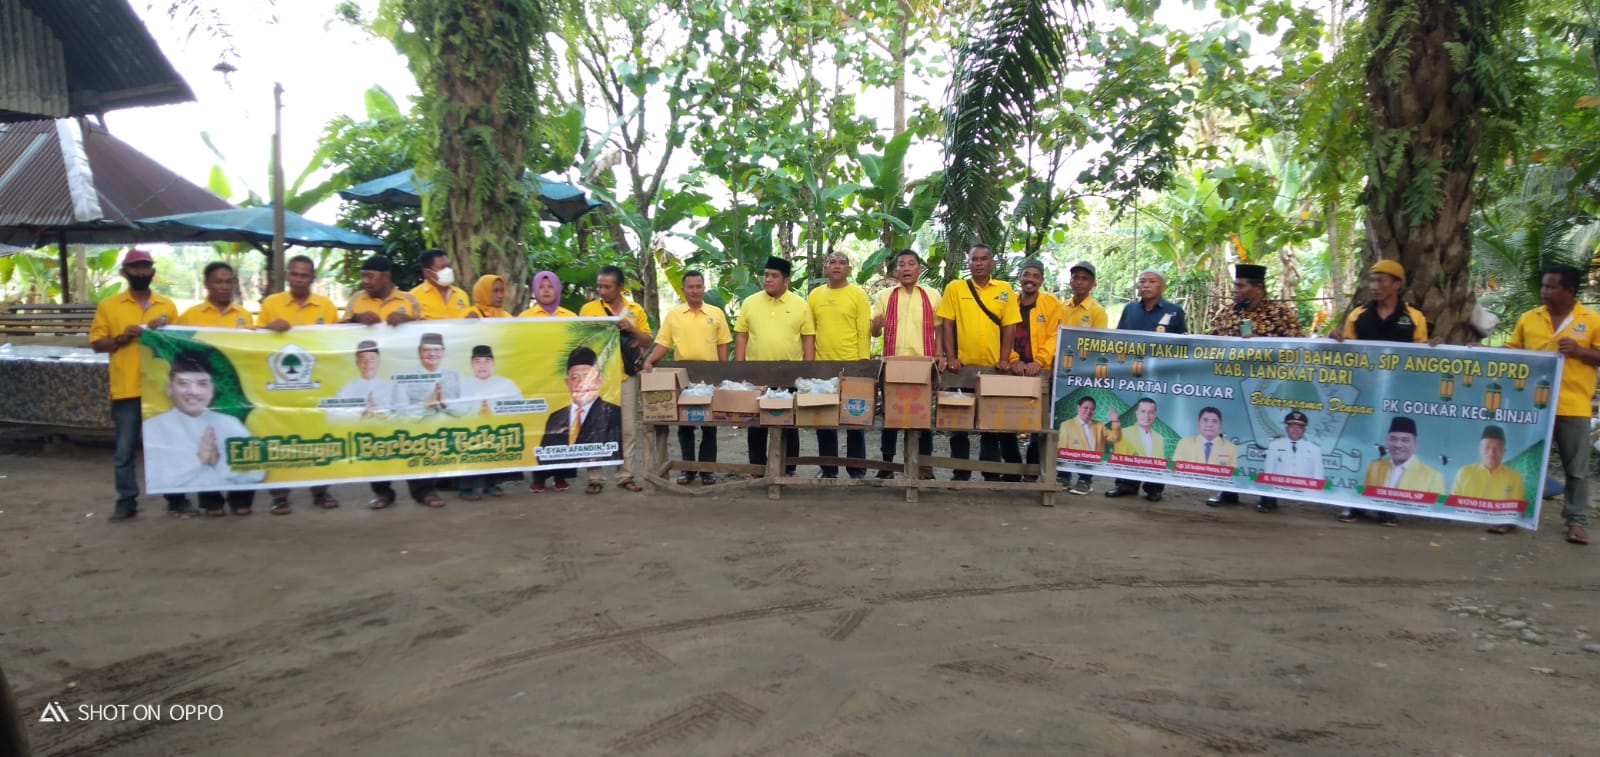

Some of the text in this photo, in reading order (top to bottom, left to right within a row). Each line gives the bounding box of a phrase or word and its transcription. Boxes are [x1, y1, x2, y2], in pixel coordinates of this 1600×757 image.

[1076, 337, 1530, 379] PEMBAGIAN TAKJIL OLEH BAPAK EDI BAHAGIA, SIP ANGGOTA DPRD
[1214, 362, 1353, 385] KAB. LANGKAT DARI
[1067, 375, 1235, 399] FRAKSI PARTAI GOLKAR
[1328, 396, 1375, 417] Dengan
[1382, 399, 1538, 425] PK GOLKAR KEC. BINJAI
[357, 426, 522, 458] Berbagi Takjil
[546, 445, 567, 455] SYAH
[606, 442, 618, 451] SH
[407, 451, 522, 468] di Bulan Ramadhan
